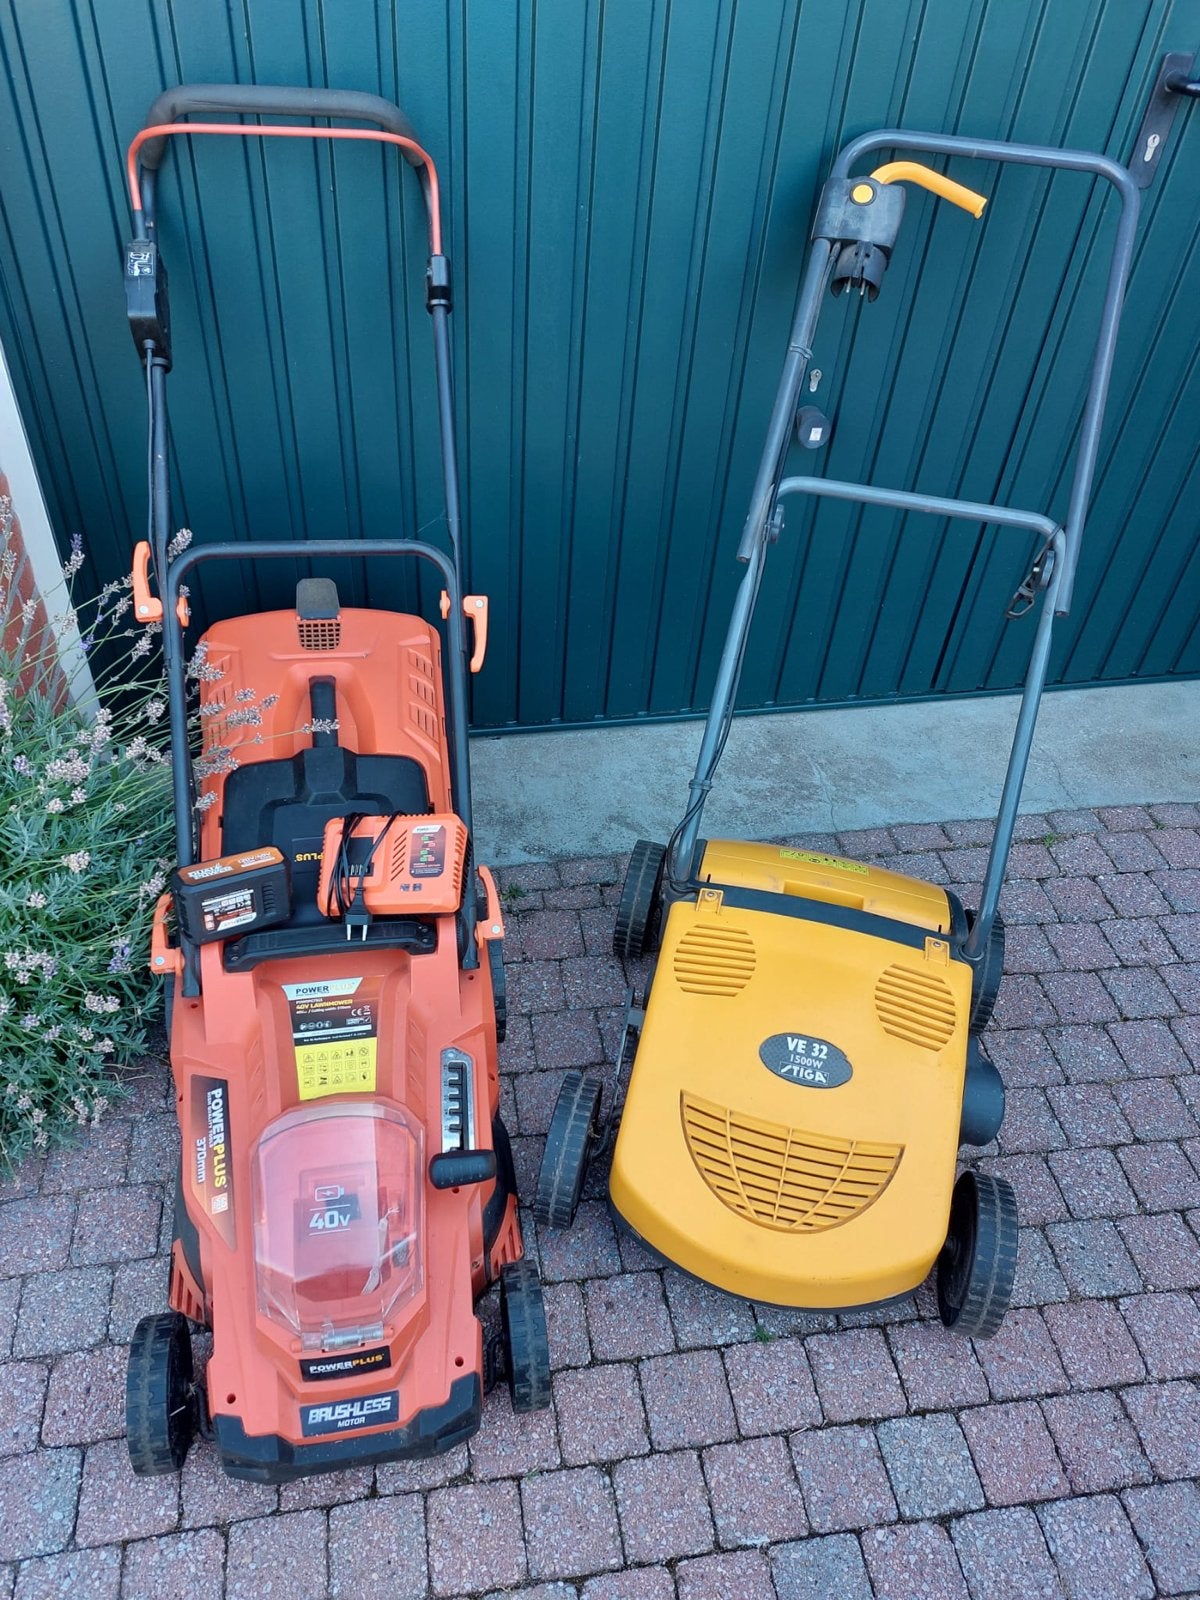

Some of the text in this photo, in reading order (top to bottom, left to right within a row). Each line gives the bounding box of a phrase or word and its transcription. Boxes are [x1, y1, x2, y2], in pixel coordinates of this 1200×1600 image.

[786, 1036, 828, 1059] VE 32
[790, 1054, 824, 1069] 1500W
[780, 1064, 827, 1083] STIGA
[211, 1087, 227, 1188] POWERPLUS
[196, 1137, 207, 1184] 370mm
[309, 1354, 383, 1373] POWERPLUS
[308, 1396, 392, 1424] BRUSHLESS
[337, 1417, 366, 1428] MOTOR
